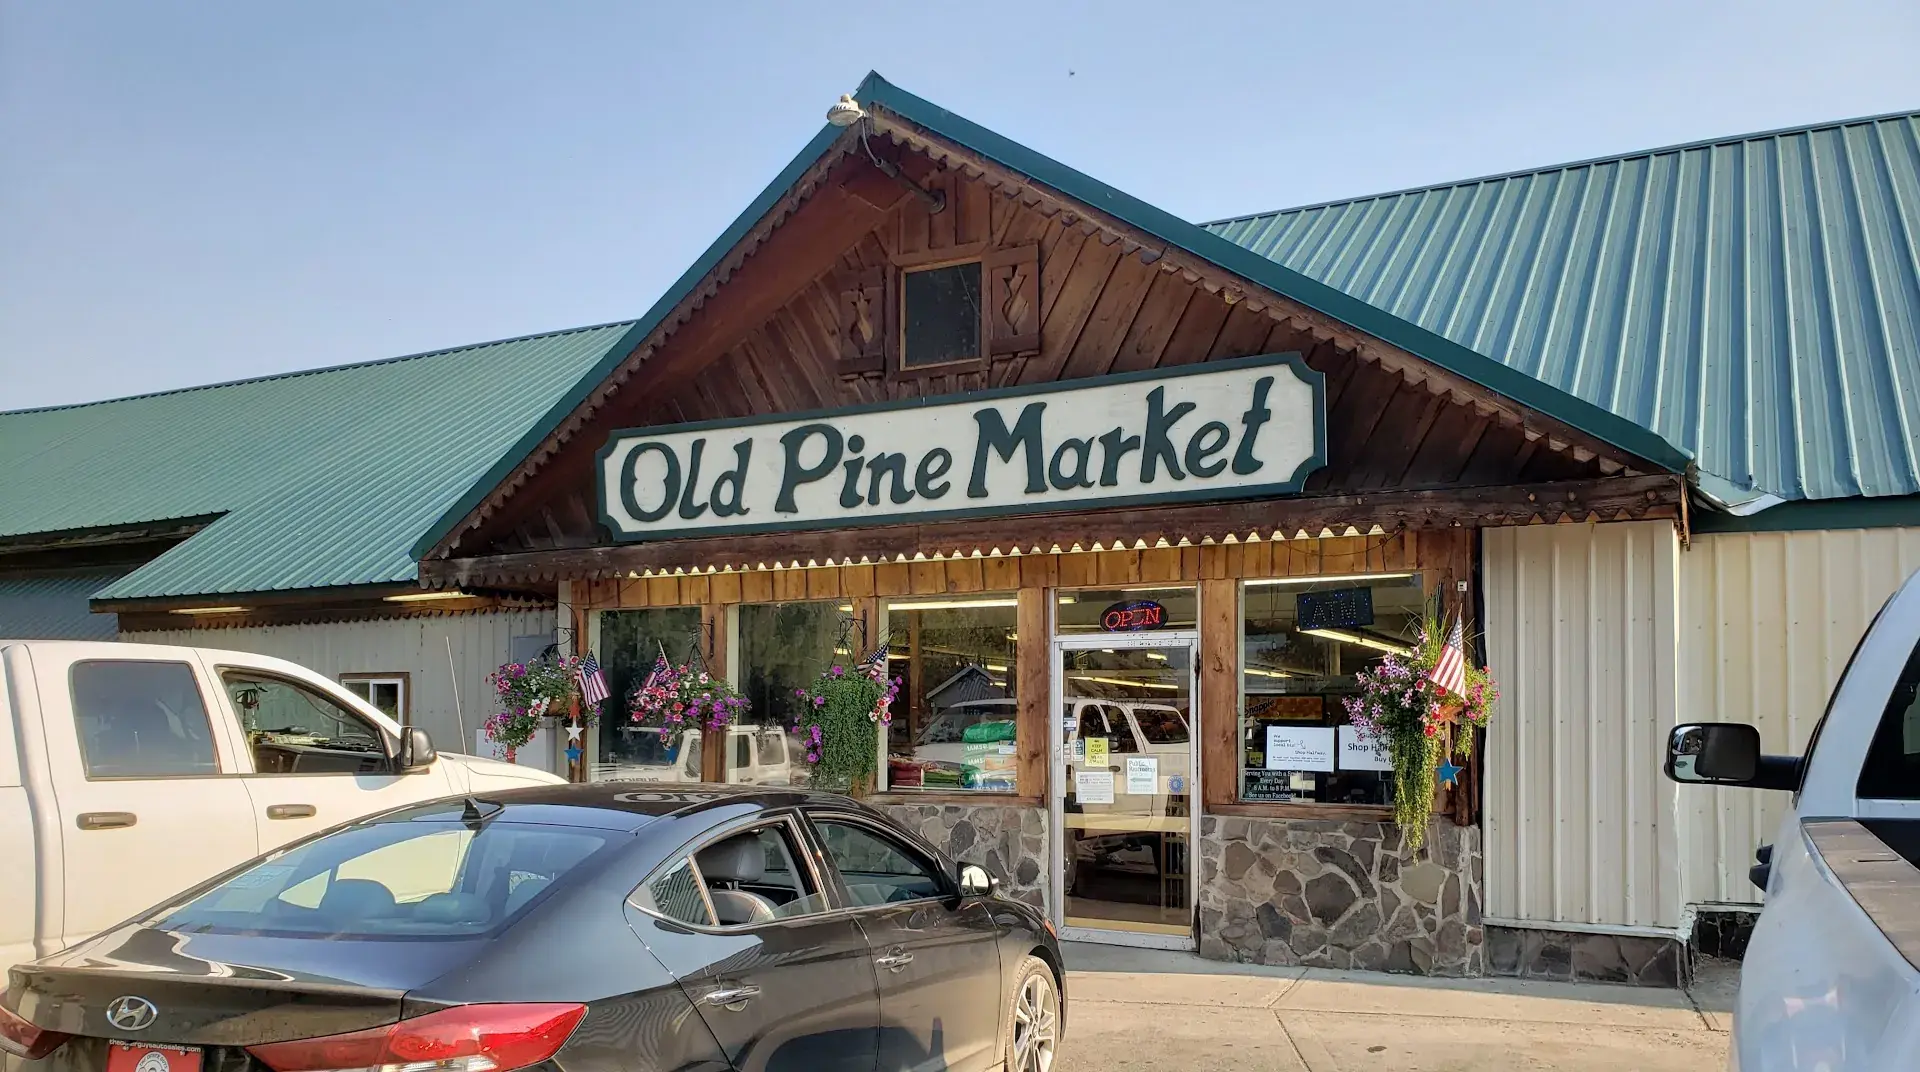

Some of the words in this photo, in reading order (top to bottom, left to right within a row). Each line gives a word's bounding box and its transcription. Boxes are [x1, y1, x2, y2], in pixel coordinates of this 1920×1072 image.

[620, 438, 754, 523] Old
[777, 423, 954, 514] Pine
[967, 375, 1274, 500] Market
[1105, 606, 1161, 629] OPEN
[1312, 597, 1357, 623] ATM
[1244, 697, 1276, 716] Snapple
[1347, 742, 1369, 753] Shop
[1260, 777, 1273, 785] Every
[1274, 777, 1285, 785] Day
[1248, 791, 1258, 799] See
